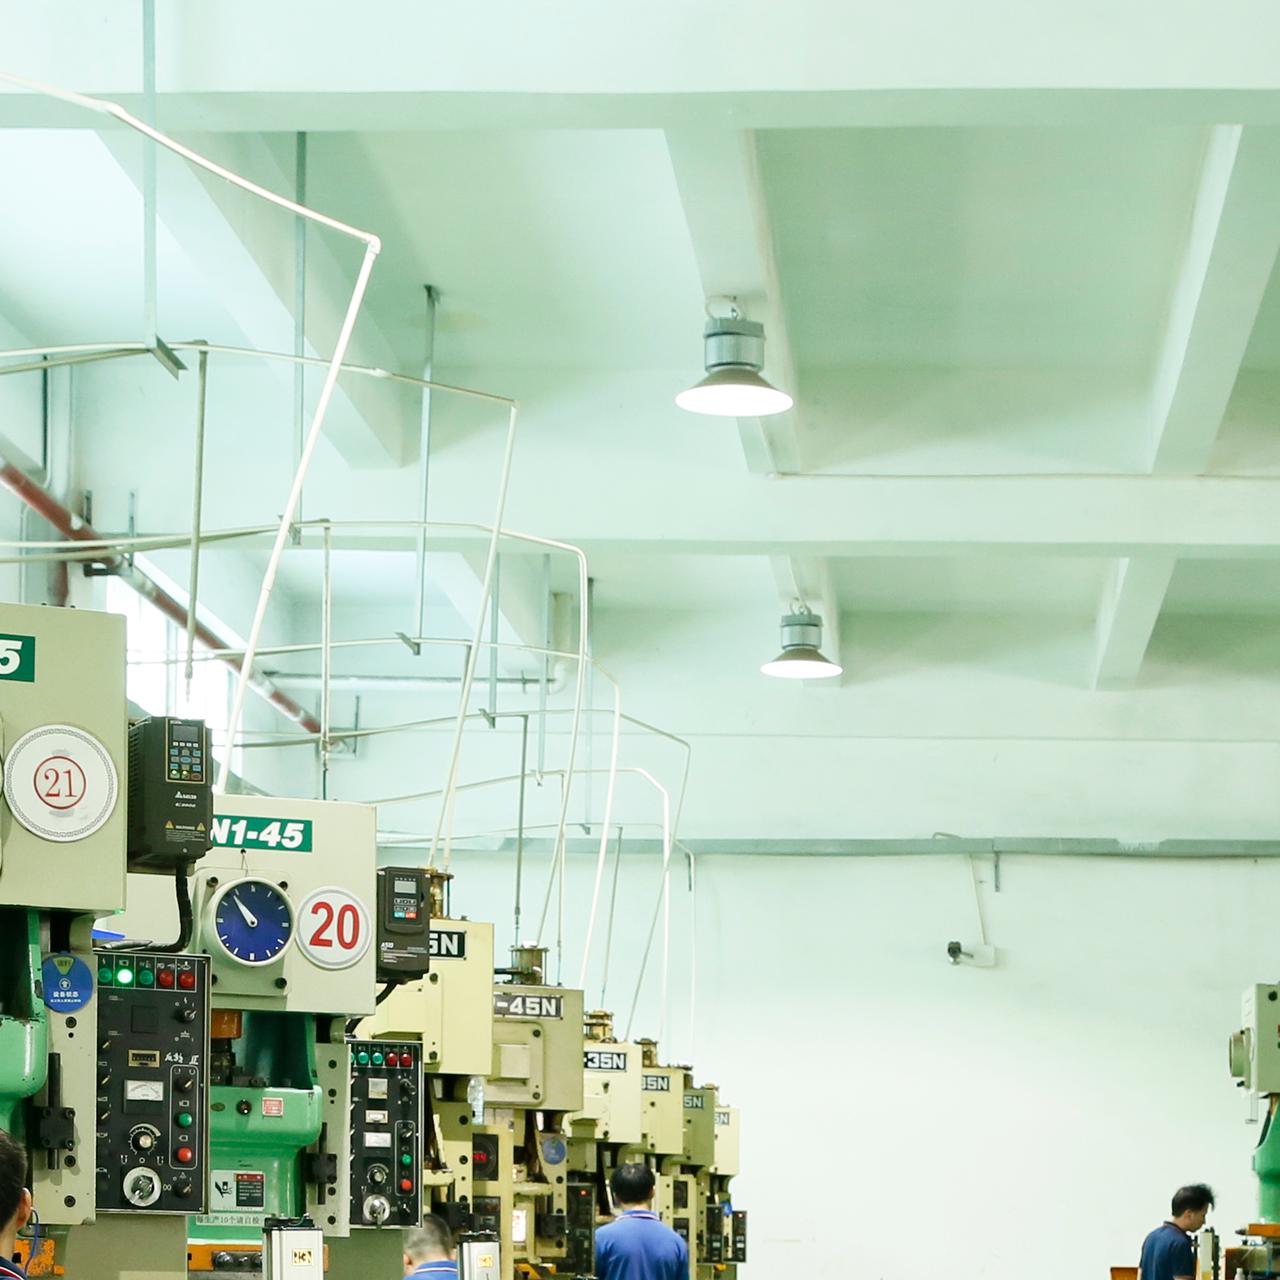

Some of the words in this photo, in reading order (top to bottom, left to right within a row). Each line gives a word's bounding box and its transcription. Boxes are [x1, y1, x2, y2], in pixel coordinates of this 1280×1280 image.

[43, 767, 78, 798] 21
[210, 817, 305, 849] N1-45
[309, 901, 360, 950] 20
[429, 933, 458, 955] 5N
[496, 996, 556, 1016] -45N
[584, 1053, 626, 1069] -35N
[684, 1096, 703, 1108] 5N
